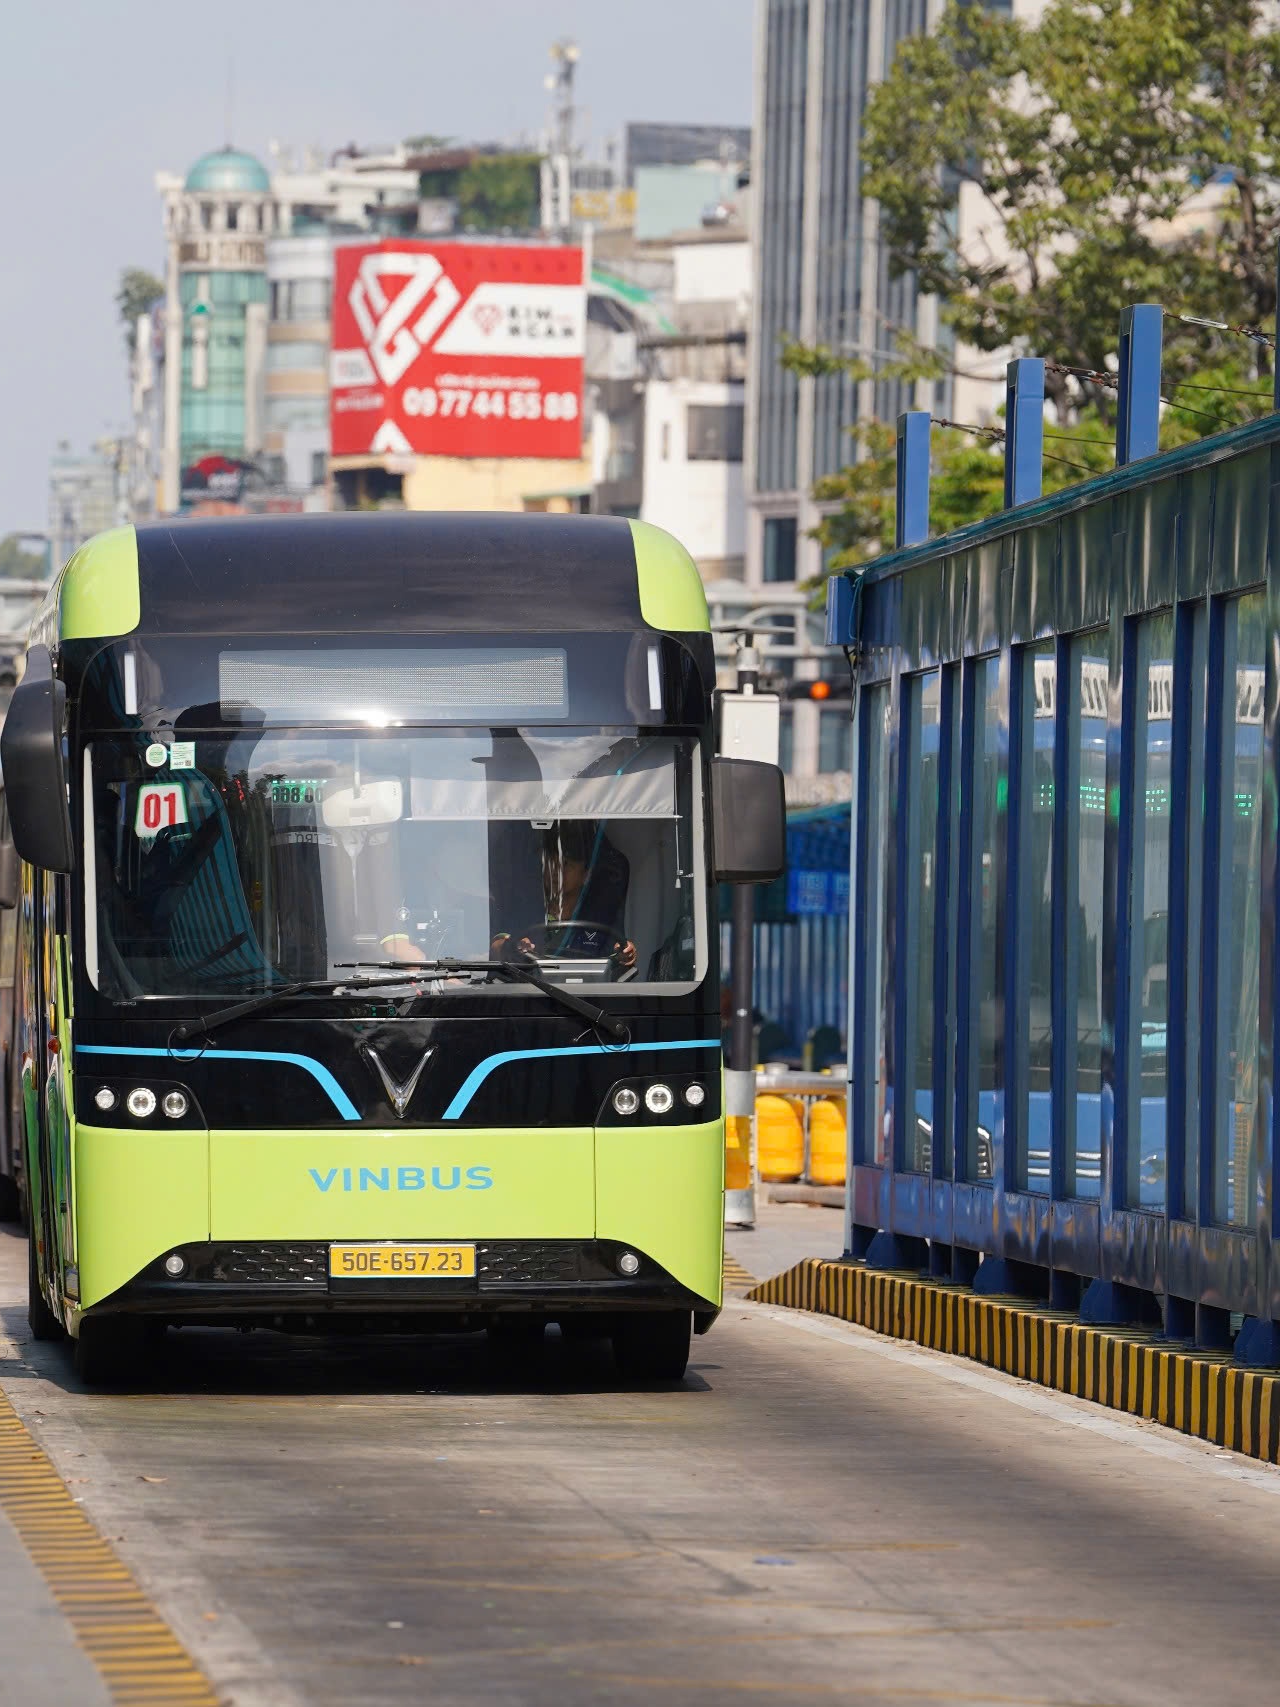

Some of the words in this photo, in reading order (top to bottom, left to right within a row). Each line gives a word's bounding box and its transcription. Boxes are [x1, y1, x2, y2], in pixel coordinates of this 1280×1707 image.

[143, 791, 177, 828] 01
[308, 1166, 494, 1192] VINBUS
[342, 1252, 463, 1272] 50E-657.23
